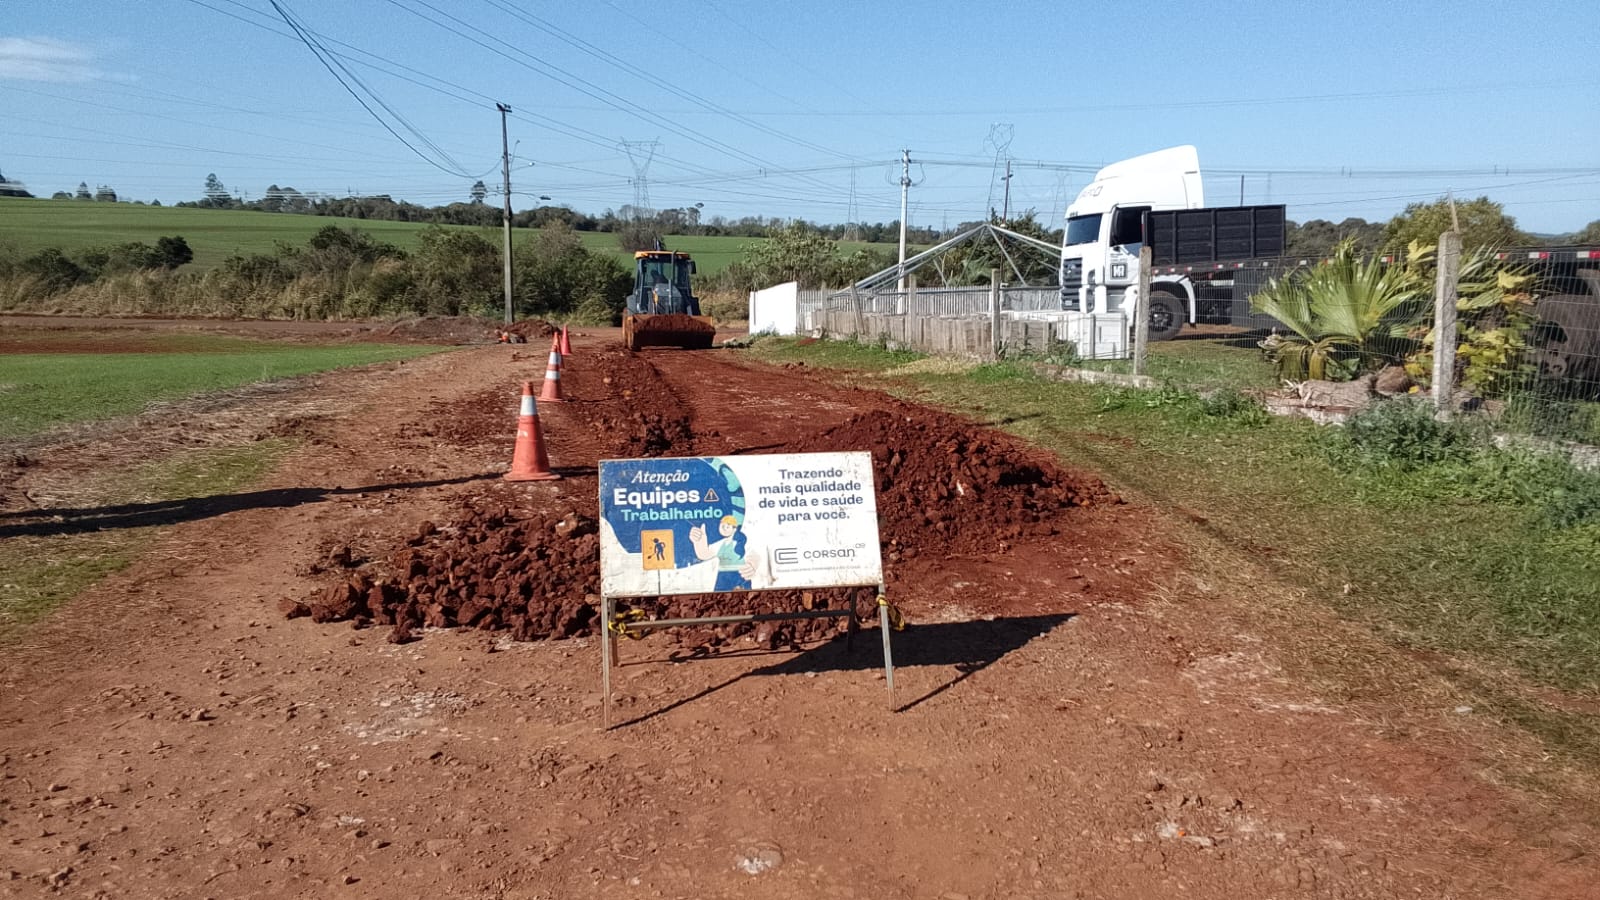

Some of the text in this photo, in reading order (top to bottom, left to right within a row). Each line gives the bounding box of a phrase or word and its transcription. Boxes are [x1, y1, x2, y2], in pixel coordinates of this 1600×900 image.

[631, 470, 690, 486] Atenção
[778, 467, 843, 480] Trazendo
[759, 480, 862, 495] mais qualidade
[613, 486, 701, 509] Equipes
[758, 493, 864, 508] de vida e saúde
[620, 506, 723, 521] Trabalhando
[778, 507, 850, 525] para você.
